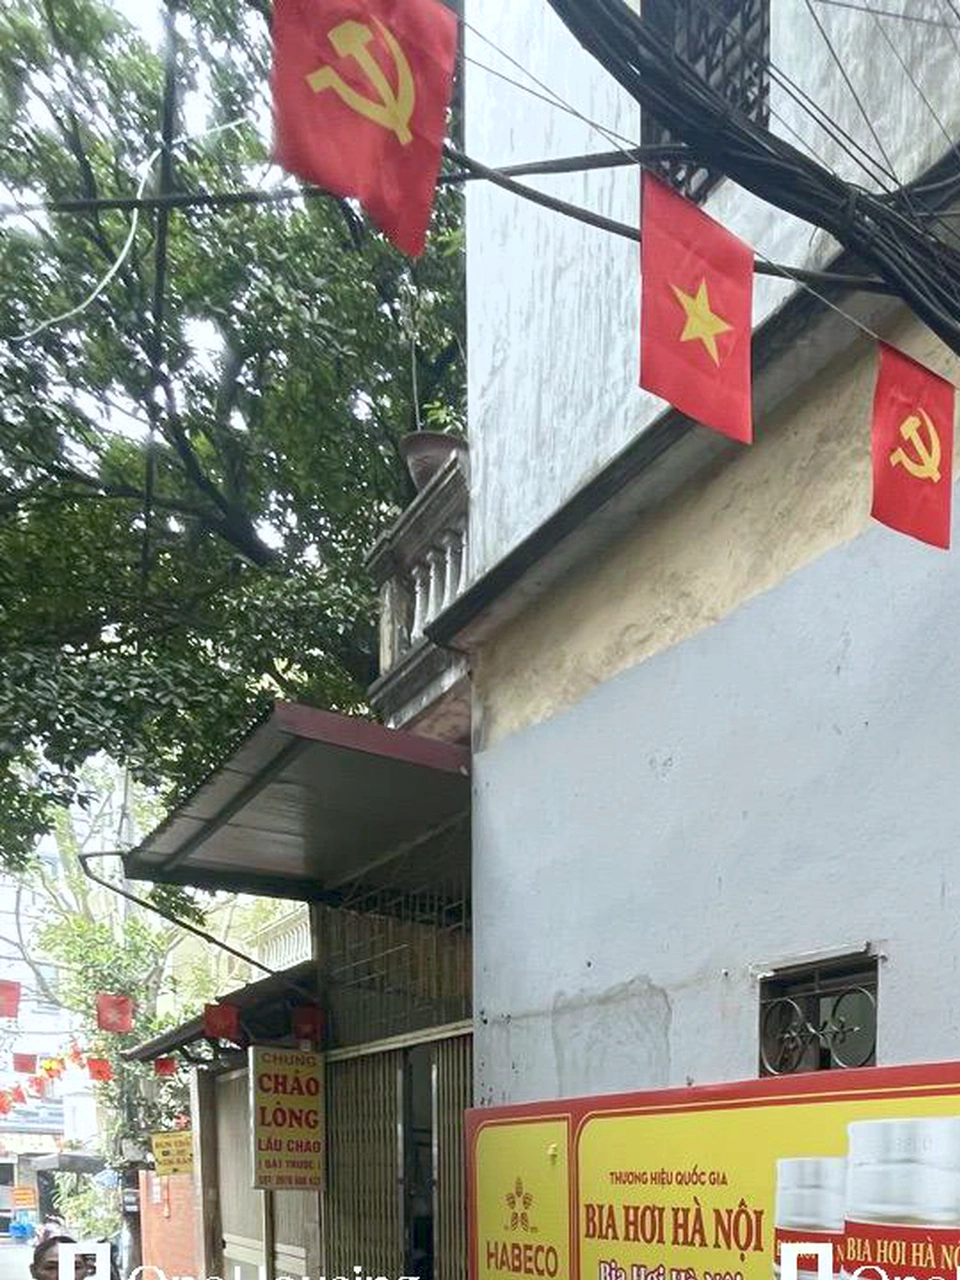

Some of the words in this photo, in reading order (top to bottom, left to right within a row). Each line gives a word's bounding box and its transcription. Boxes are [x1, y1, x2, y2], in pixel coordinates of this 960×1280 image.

[709, 1171, 728, 1186] GIA
[584, 1203, 620, 1241] BIA
[623, 1204, 666, 1246] HƠI
[671, 1196, 708, 1248] HÀ
[713, 1197, 764, 1262] NỘI
[486, 1240, 559, 1278] HABECO
[846, 1237, 871, 1262] BIA
[911, 1236, 936, 1268] HÀ
